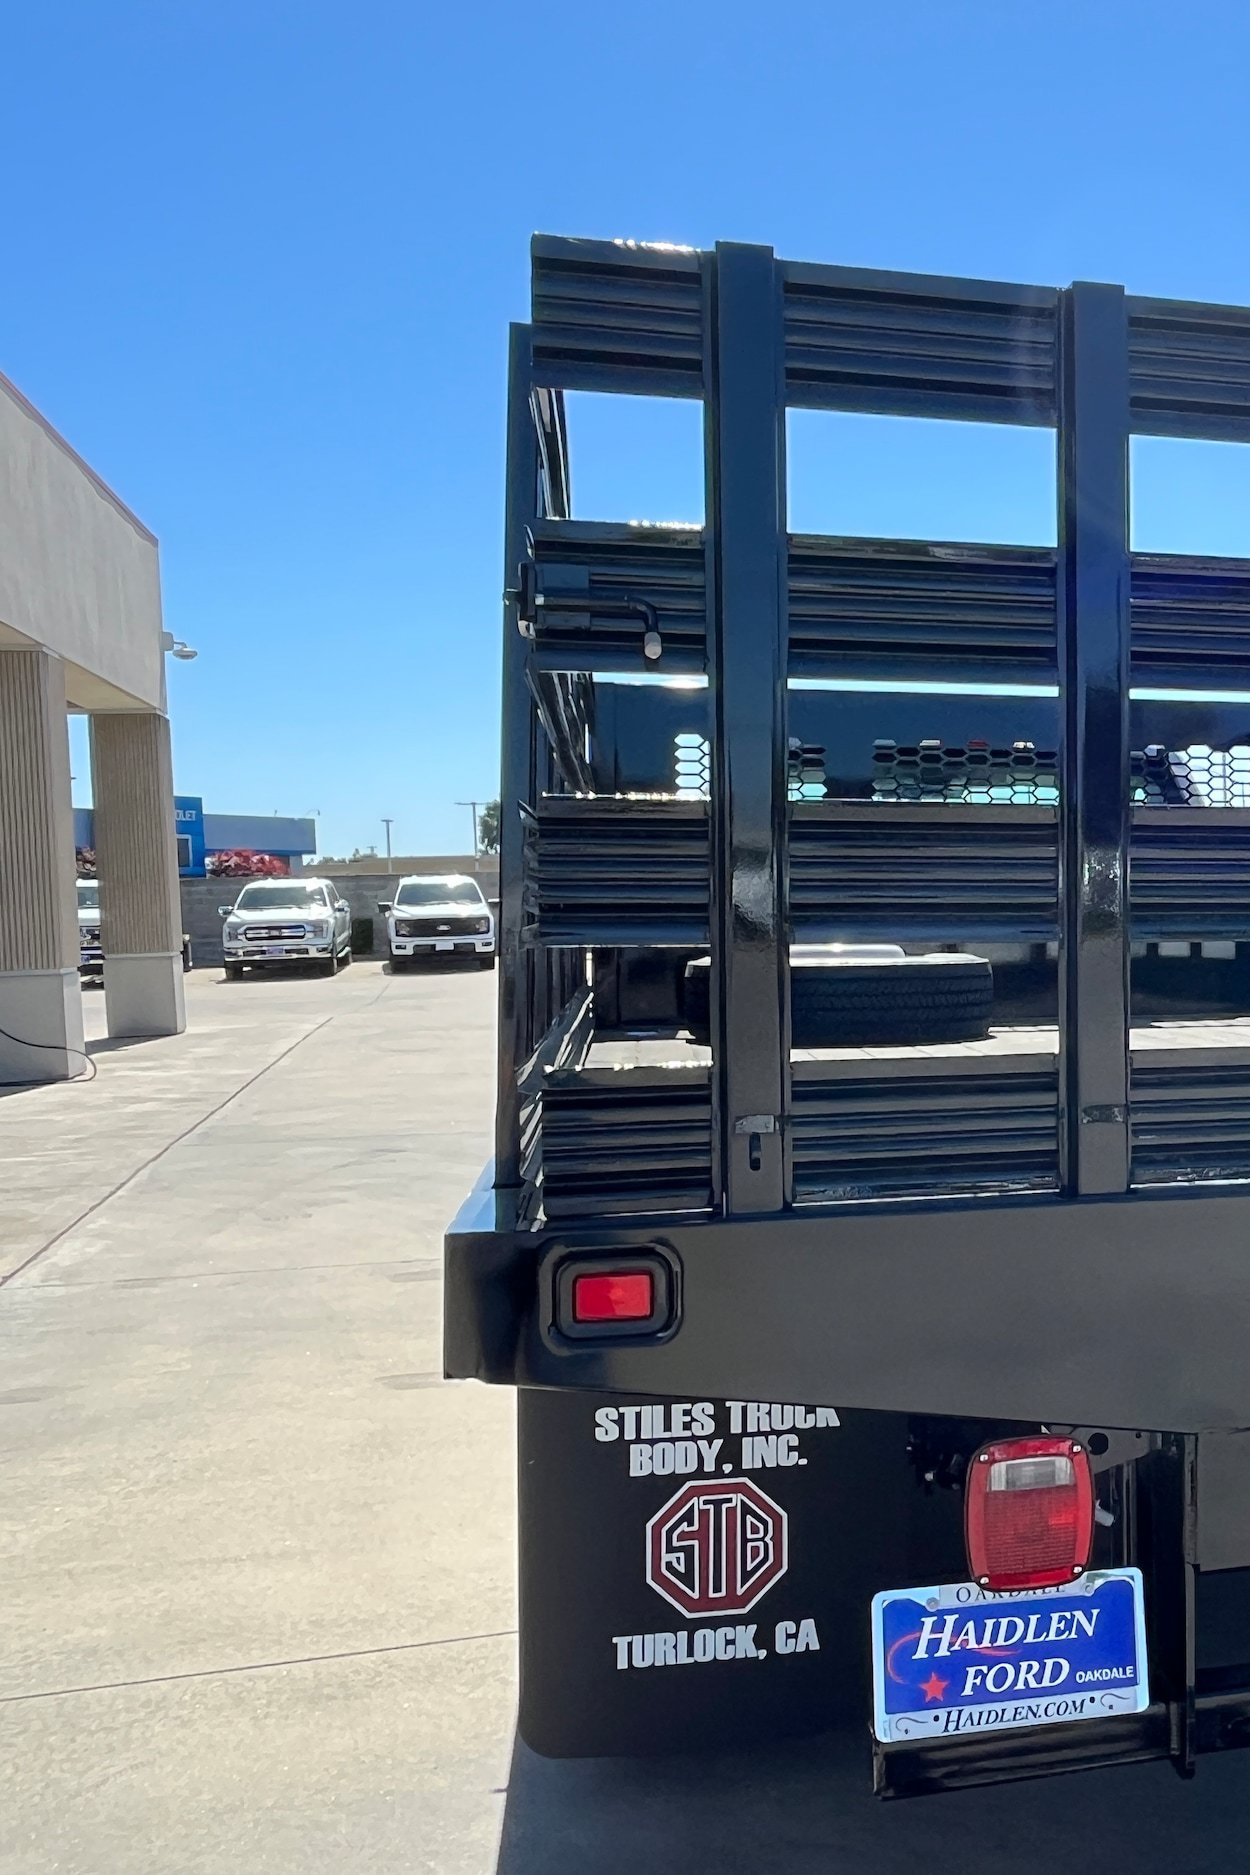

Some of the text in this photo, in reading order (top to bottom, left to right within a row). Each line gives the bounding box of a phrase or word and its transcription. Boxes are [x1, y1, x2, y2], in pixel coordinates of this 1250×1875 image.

[594, 1402, 716, 1442] STILES
[629, 1433, 808, 1477] BODY, INC.
[660, 1492, 774, 1600] STB
[612, 1618, 821, 1670] TURLOCK, CA
[911, 1608, 1100, 1660] HAIDLEN
[961, 1657, 1134, 1697] FORD OAKDALE
[941, 1698, 1086, 1734] HAIDLEN.COM
